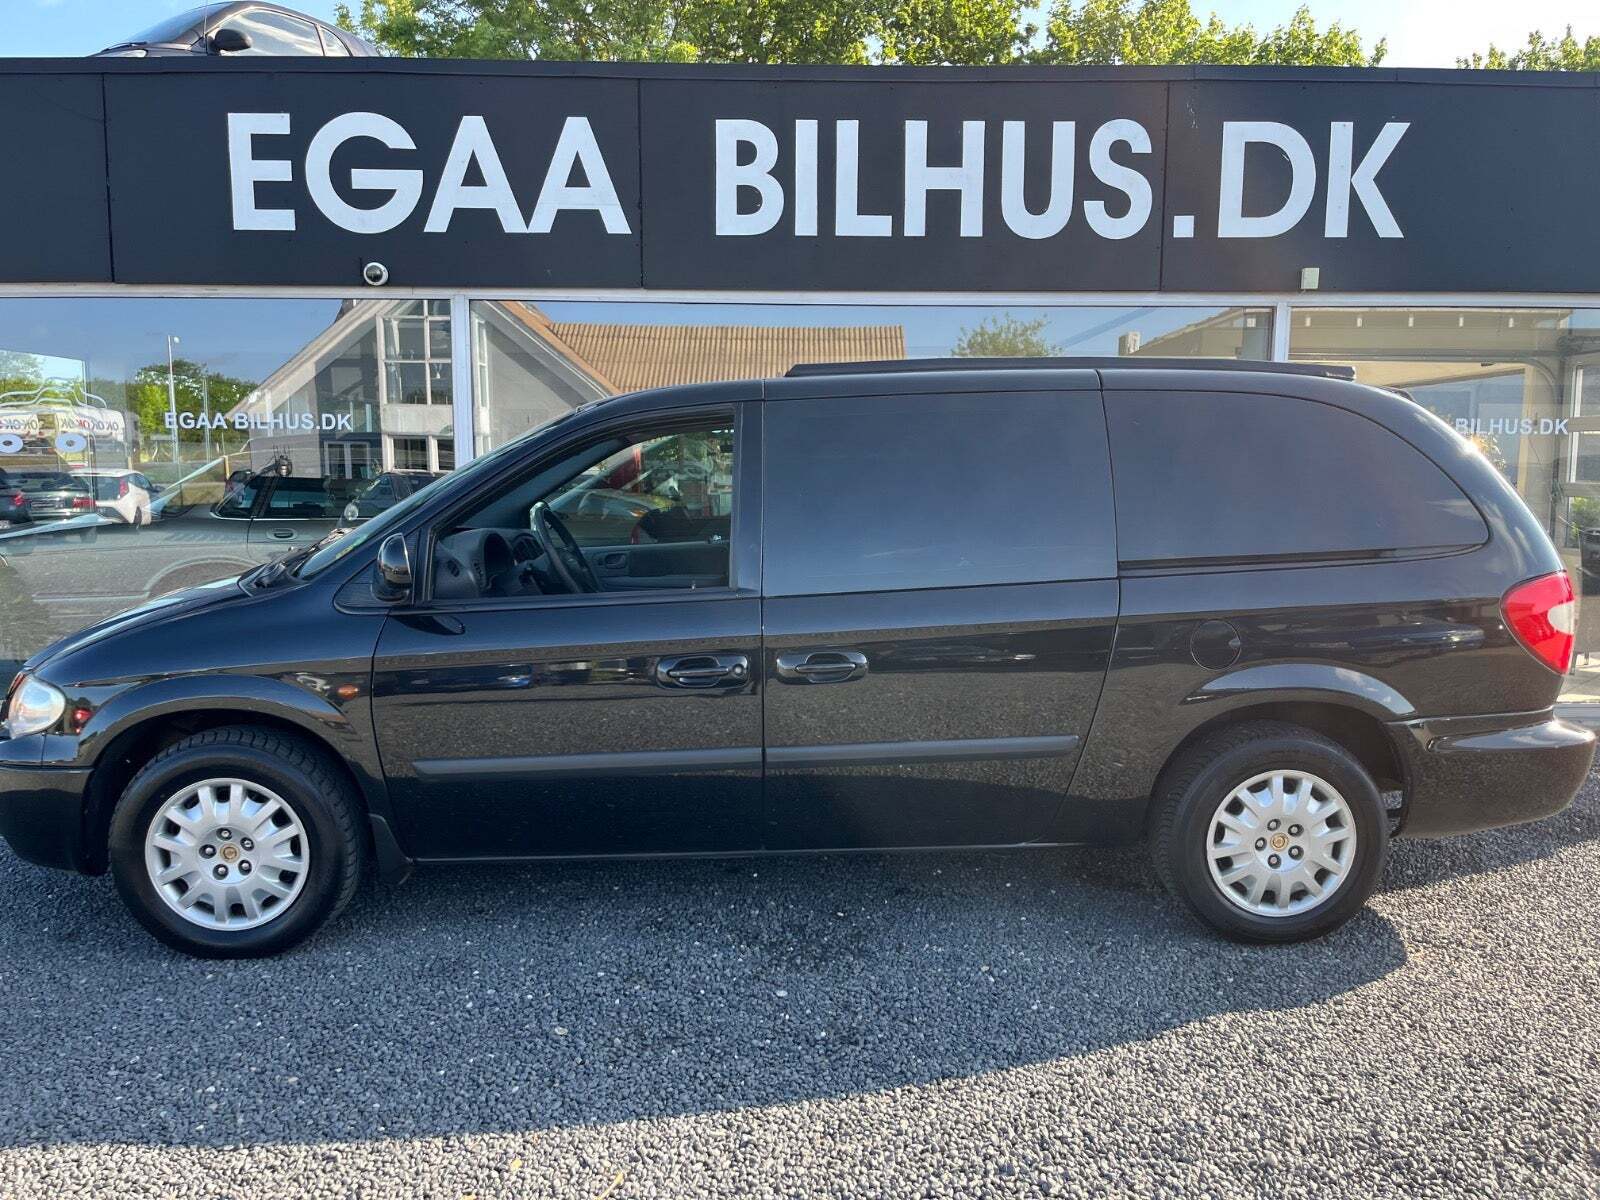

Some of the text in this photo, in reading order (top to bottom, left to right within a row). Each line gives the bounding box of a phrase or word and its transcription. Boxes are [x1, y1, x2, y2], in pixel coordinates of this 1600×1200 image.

[226, 111, 1412, 241] EGAA BILHUS.DK
[164, 411, 352, 431] EGAA BILHUS.DK
[1455, 417, 1570, 436] BILHUS.DK
